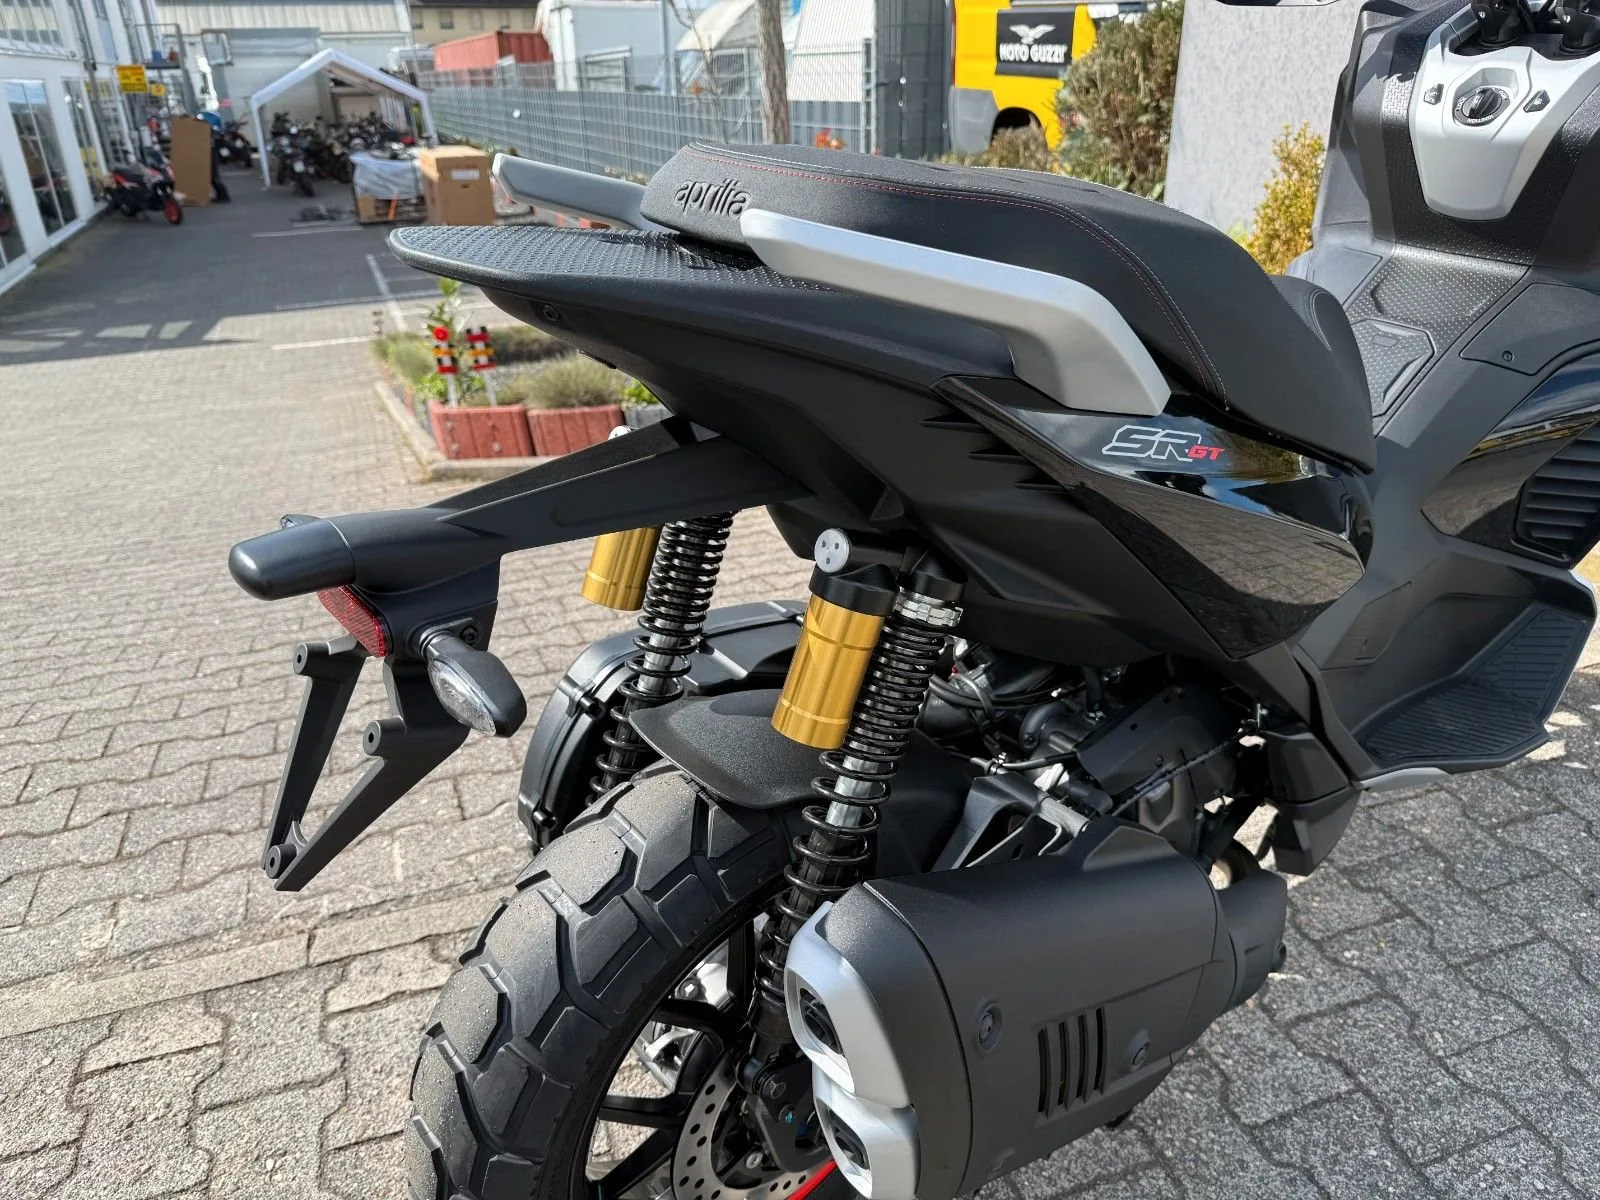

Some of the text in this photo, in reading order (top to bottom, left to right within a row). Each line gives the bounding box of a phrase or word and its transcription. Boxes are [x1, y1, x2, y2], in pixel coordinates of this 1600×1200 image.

[999, 43, 1067, 63] MOTO GUZZI
[674, 178, 751, 219] aprilia
